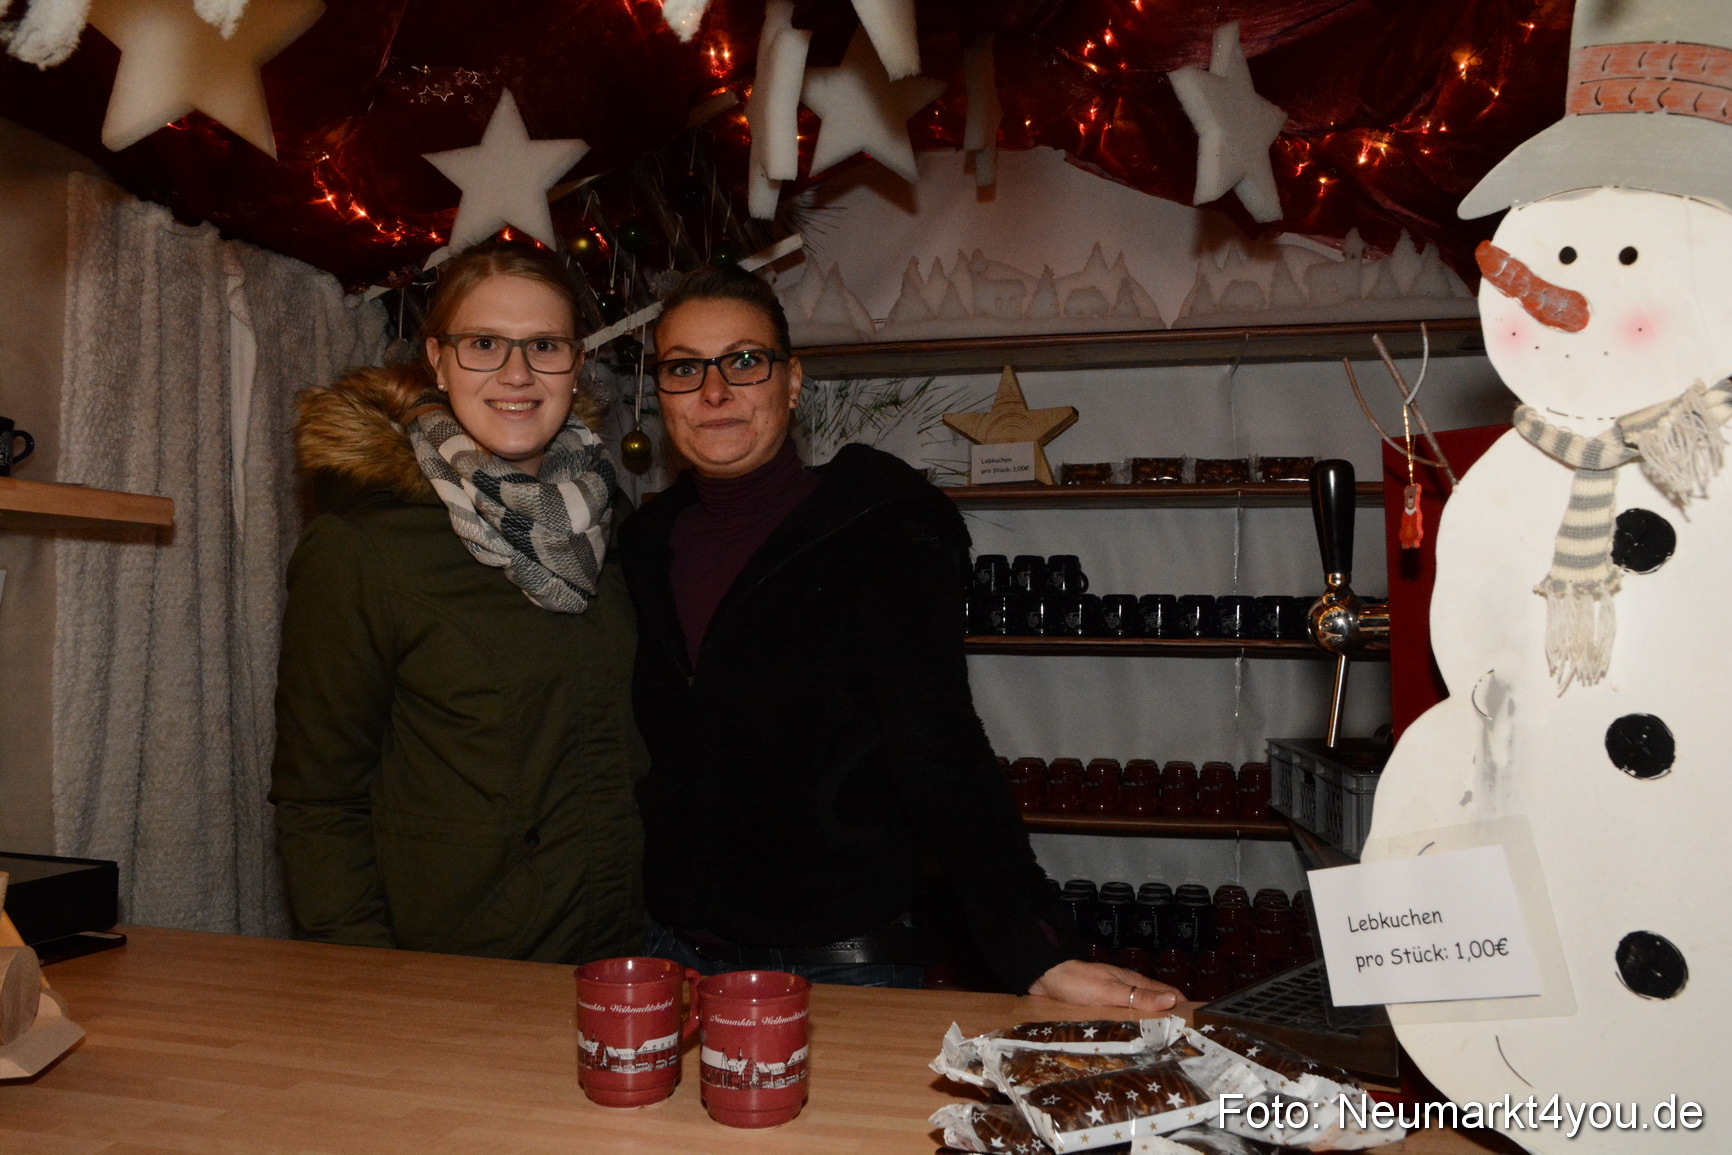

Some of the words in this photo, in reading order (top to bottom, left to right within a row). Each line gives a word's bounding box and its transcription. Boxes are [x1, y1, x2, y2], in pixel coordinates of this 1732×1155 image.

[980, 457, 1012, 465] Lebkuchen
[1347, 908, 1443, 933] Lebkuchen
[1355, 954, 1384, 973] pro
[1391, 944, 1449, 966] Stück:
[1454, 937, 1510, 962] 1,00€
[710, 1014, 757, 1027] Neumarkter
